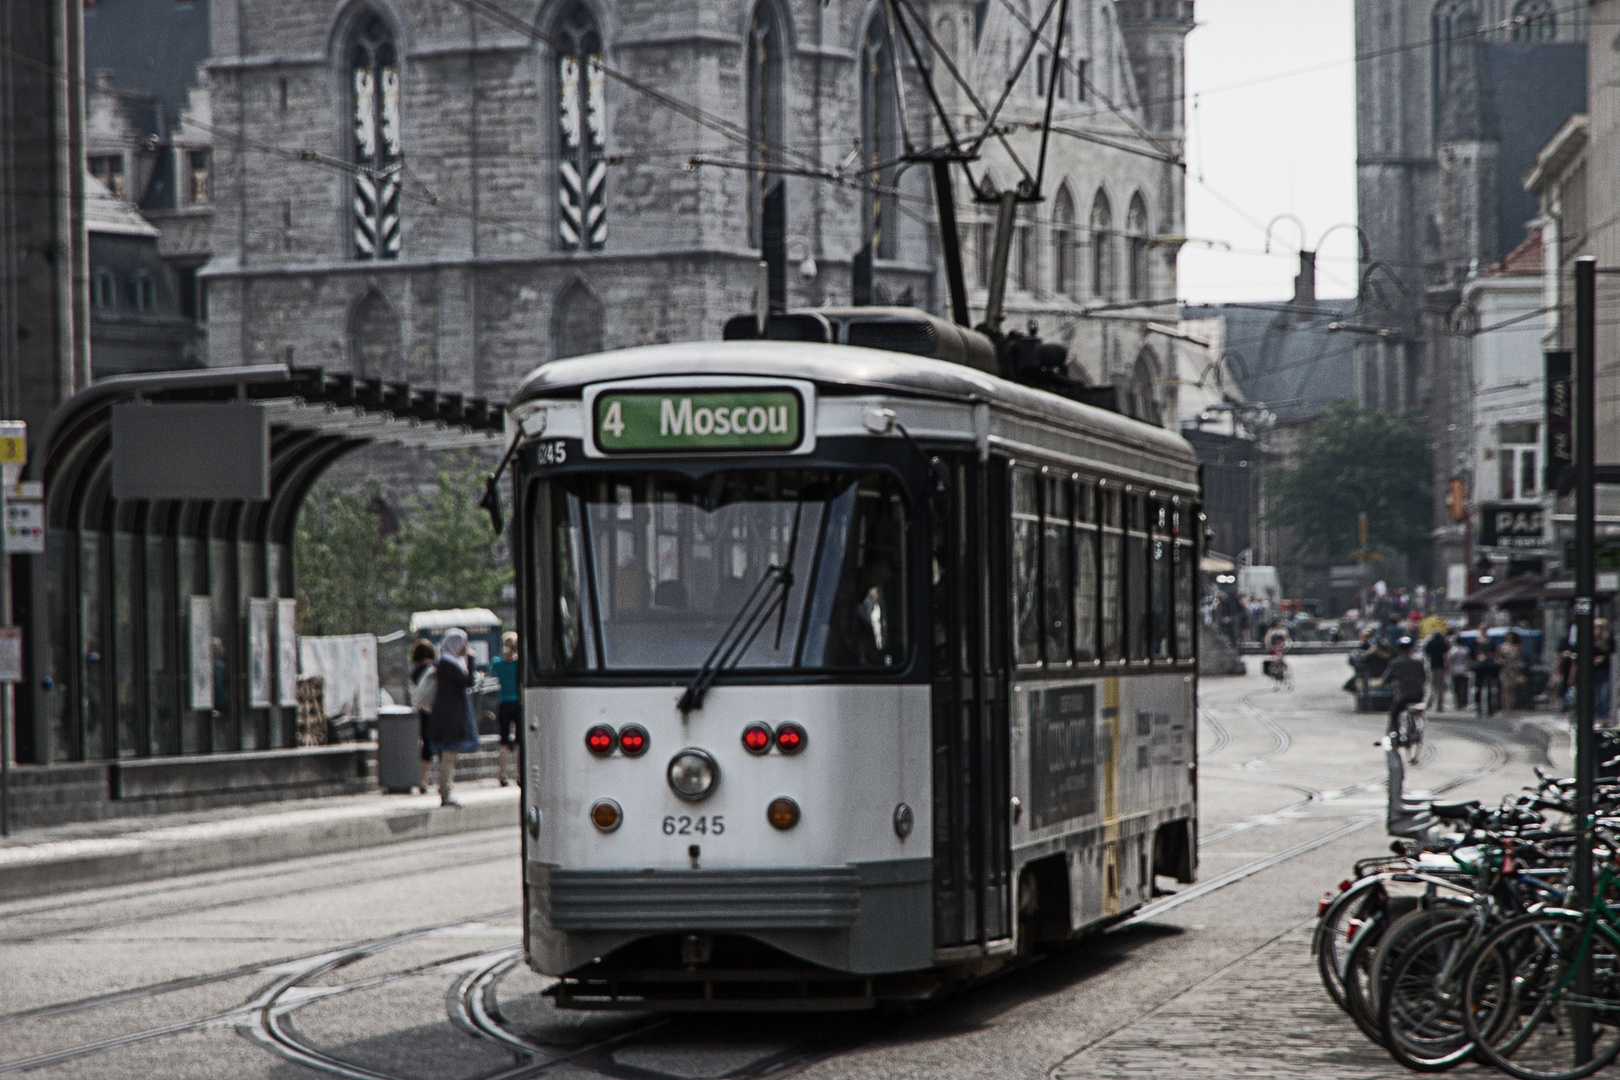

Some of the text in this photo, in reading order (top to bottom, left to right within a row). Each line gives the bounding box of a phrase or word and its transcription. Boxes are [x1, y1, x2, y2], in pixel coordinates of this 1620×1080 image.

[602, 398, 788, 437] 4 Moscou
[662, 815, 726, 836] 6245
